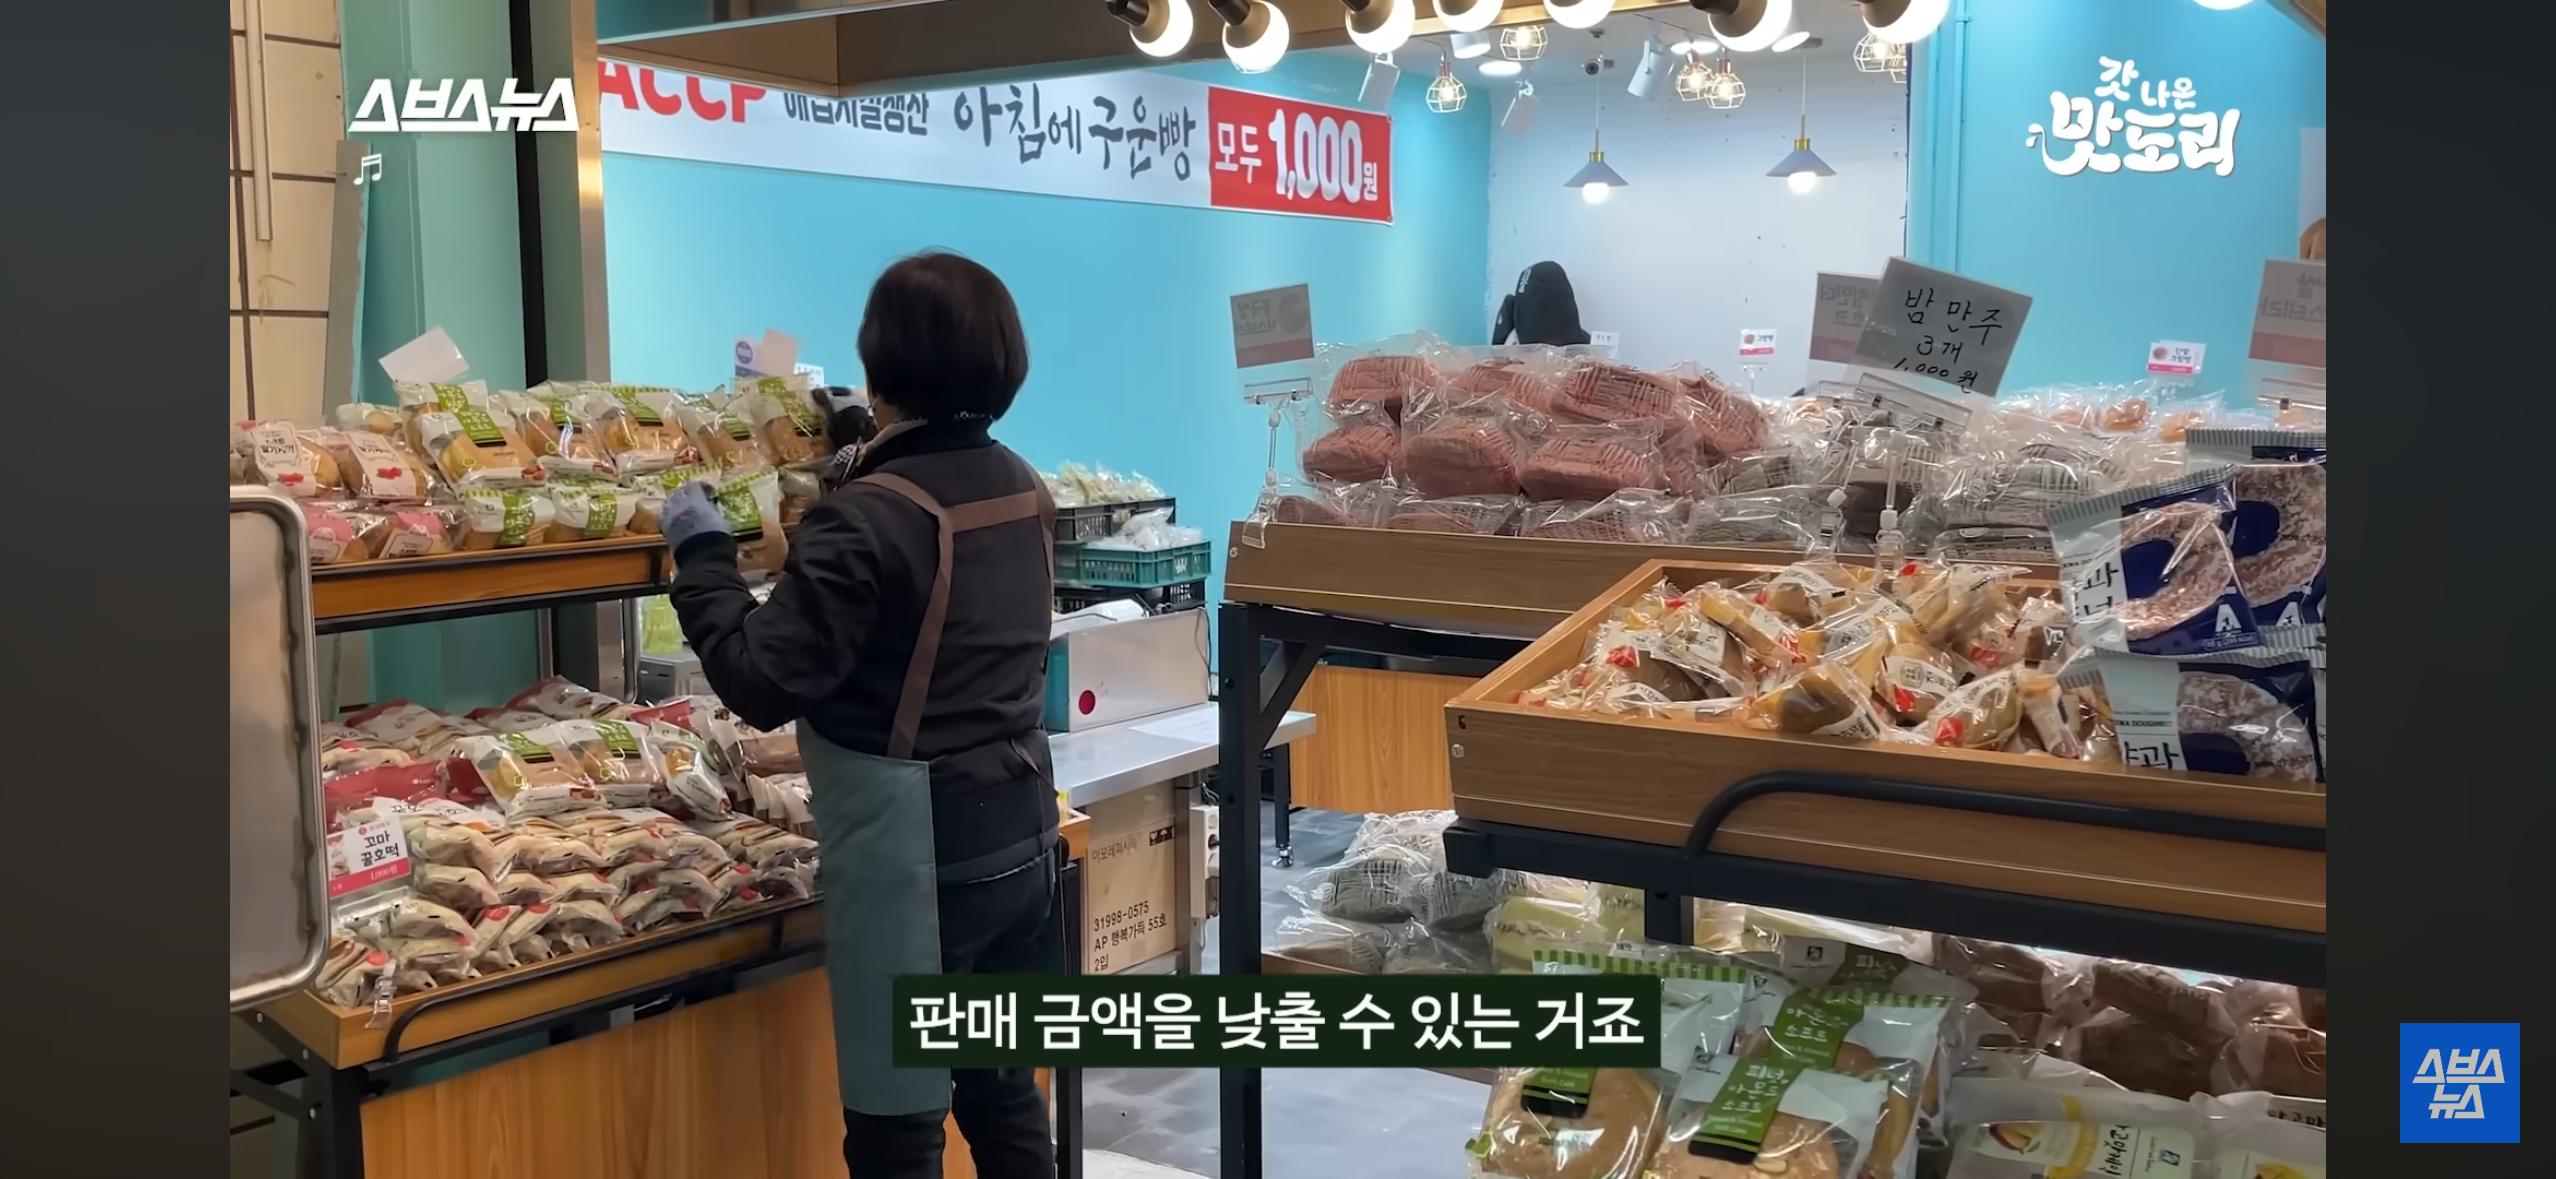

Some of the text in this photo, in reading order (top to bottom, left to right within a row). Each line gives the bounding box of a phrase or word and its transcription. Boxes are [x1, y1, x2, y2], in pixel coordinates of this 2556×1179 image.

[1215, 122, 1262, 184] 모두
[364, 830, 391, 849] 꼬마
[360, 843, 400, 867] 꿀호떡
[1093, 900, 1150, 932] 31998-0575
[1094, 912, 1168, 952] AP 행복가득 55호
[1094, 953, 1110, 972] 2입
